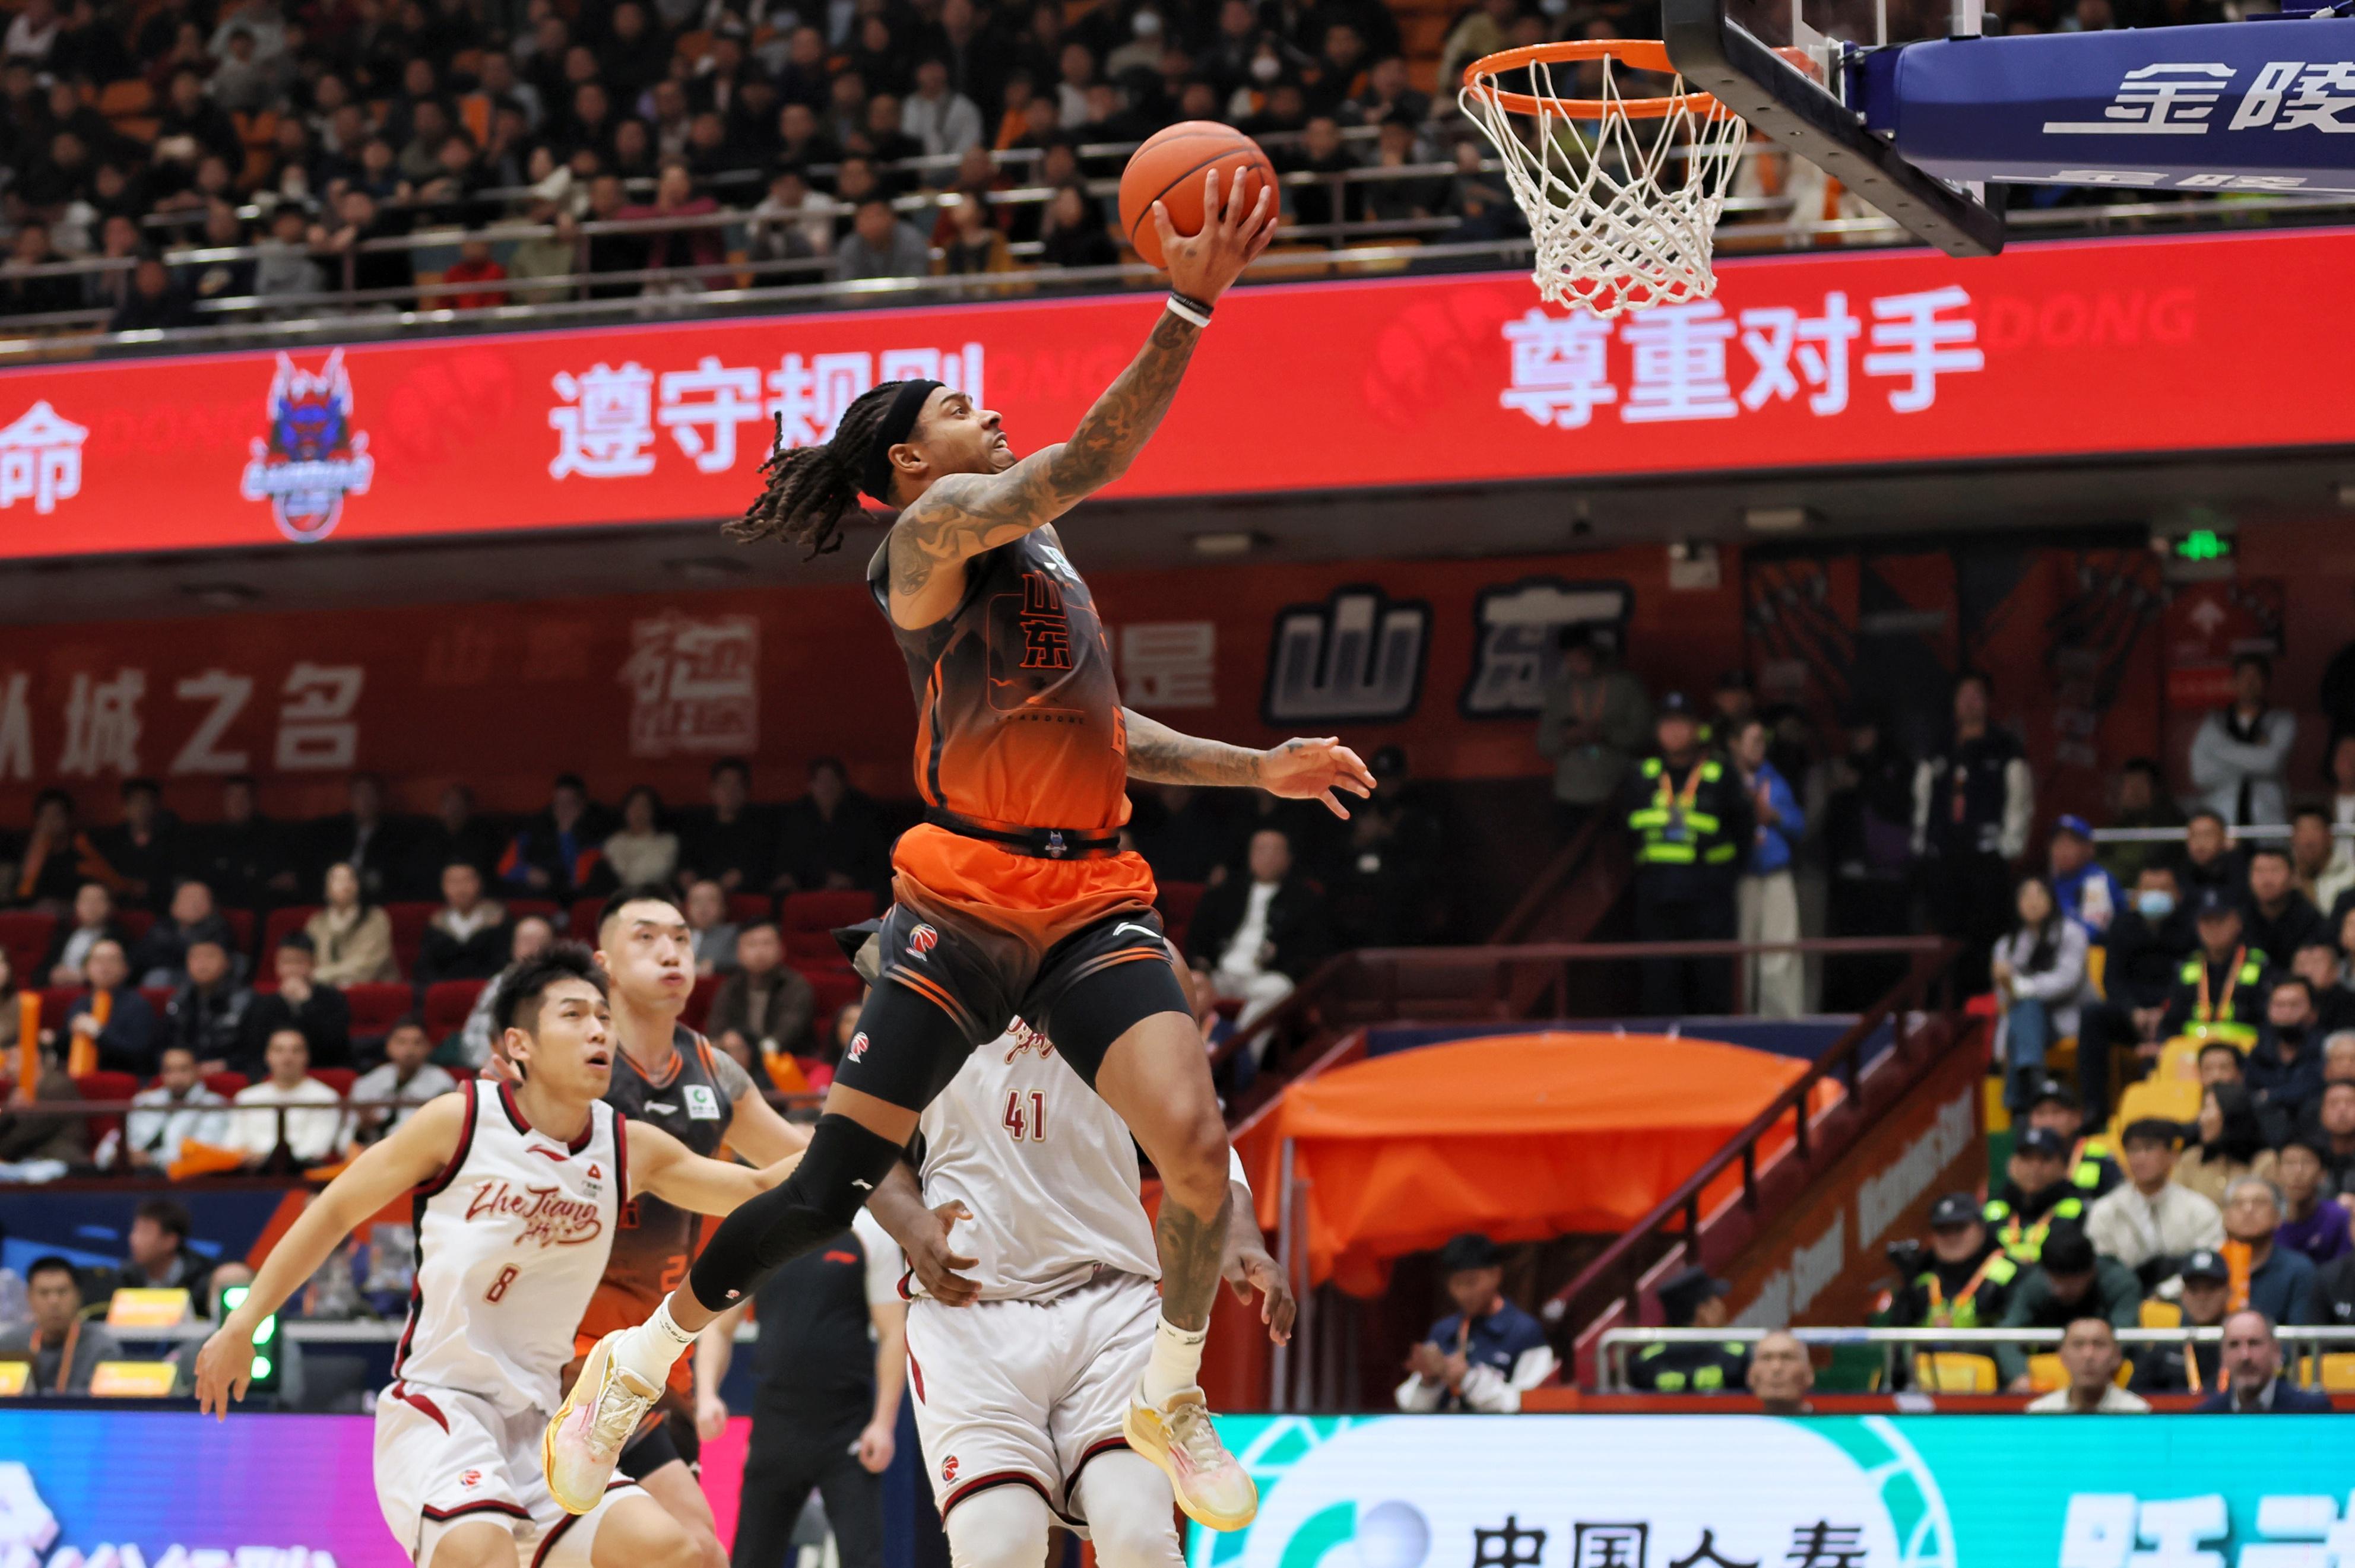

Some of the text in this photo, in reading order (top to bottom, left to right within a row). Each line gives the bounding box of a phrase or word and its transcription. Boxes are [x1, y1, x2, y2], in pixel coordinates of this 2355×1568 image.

[2043, 62, 2355, 134] 金陵
[1499, 285, 1985, 430] 尊重对手
[1020, 570, 1072, 669] 山东
[1003, 1088, 1047, 1142] 41
[483, 1263, 521, 1304] 8
